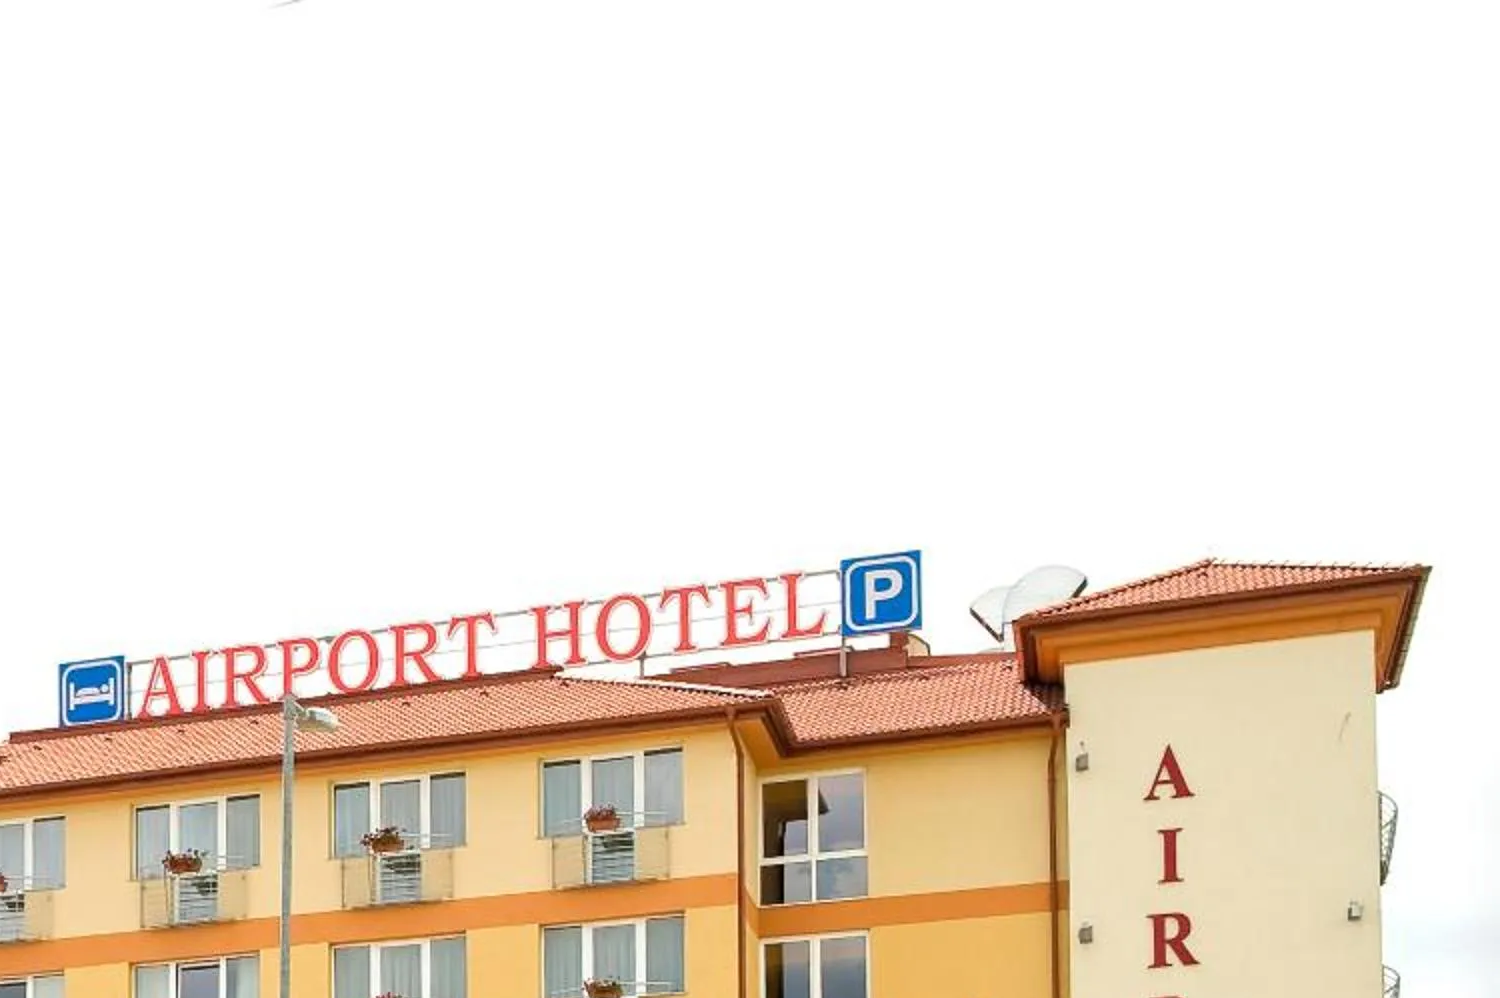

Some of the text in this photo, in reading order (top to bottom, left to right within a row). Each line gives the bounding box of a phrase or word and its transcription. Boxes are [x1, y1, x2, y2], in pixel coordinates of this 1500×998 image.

[136, 570, 829, 719] AIRPORT HOTEL
[864, 570, 903, 620] P
